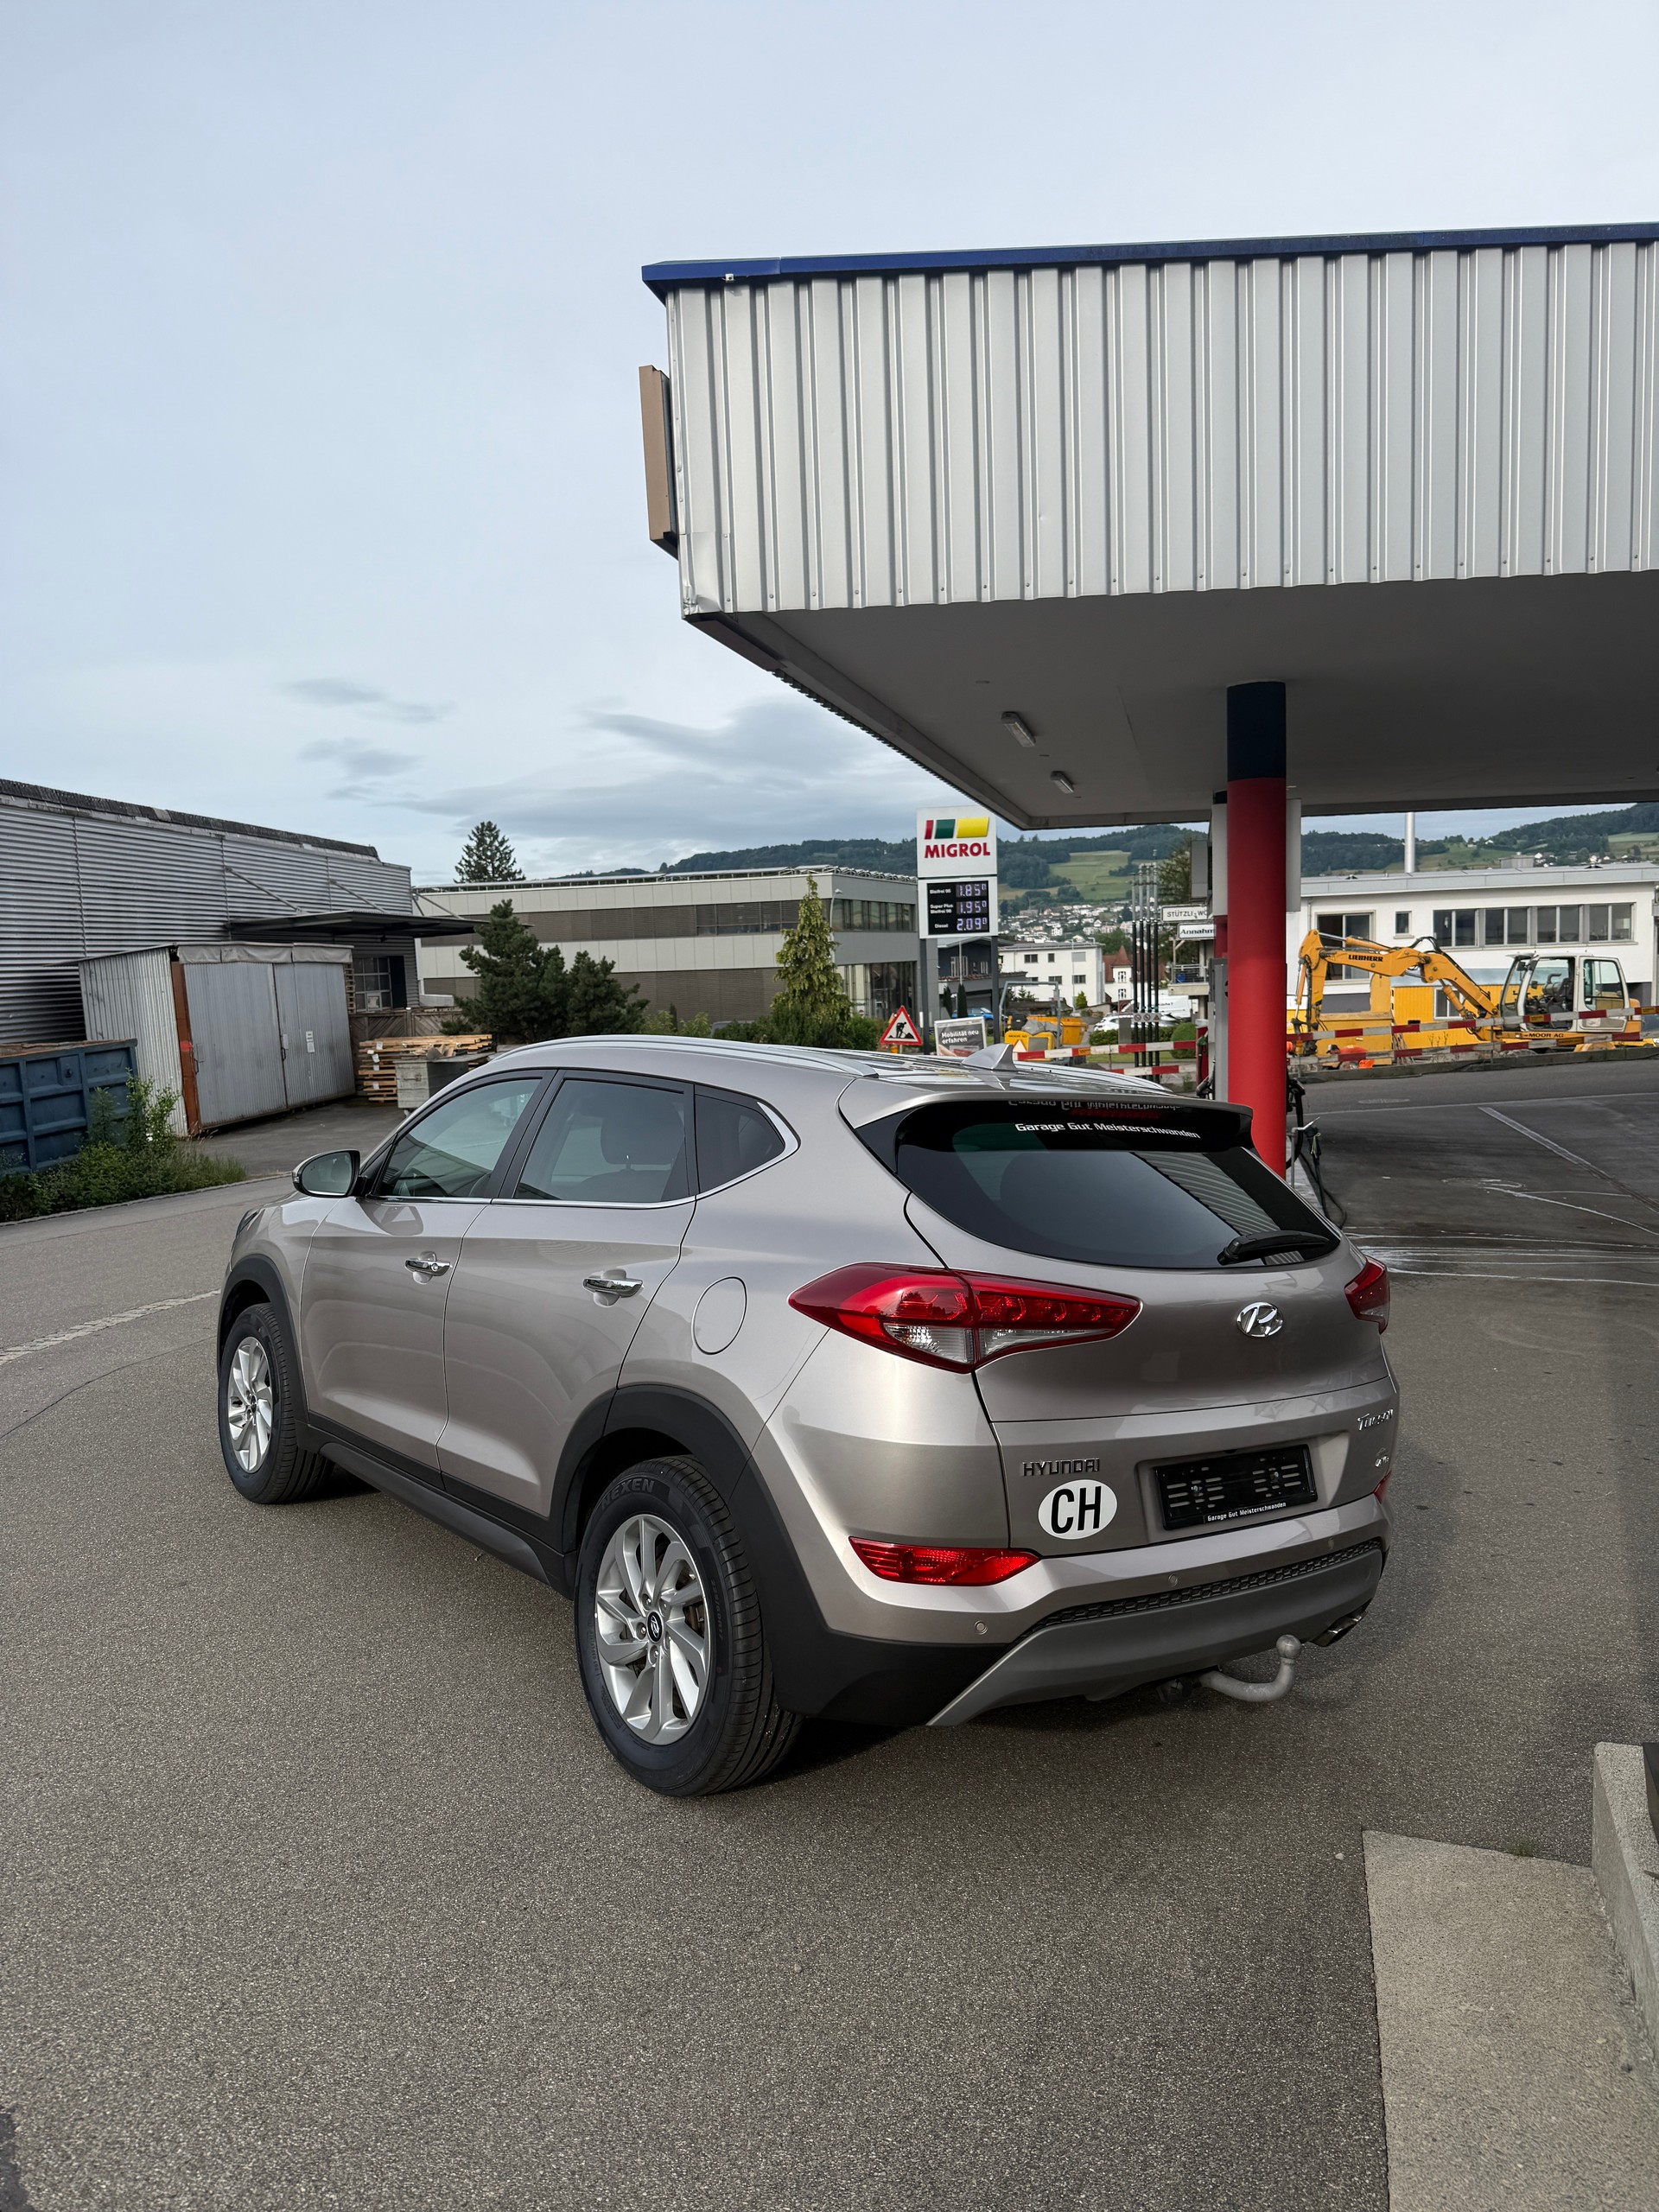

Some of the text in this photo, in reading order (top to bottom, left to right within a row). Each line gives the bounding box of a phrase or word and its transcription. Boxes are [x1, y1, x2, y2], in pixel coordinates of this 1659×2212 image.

[924, 842, 990, 858] MIGROL
[941, 1030, 967, 1039] Mobilität
[941, 1036, 968, 1045] erfahren
[1015, 1122, 1201, 1139] Garage Gut Meisterschwanden
[1022, 1458, 1100, 1477] HYUNDAI
[602, 1478, 655, 1511] NEXEN
[1051, 1486, 1102, 1535] CH
[1207, 1513, 1227, 1522] Garage
[1239, 1501, 1287, 1516] Meisterschwanden
